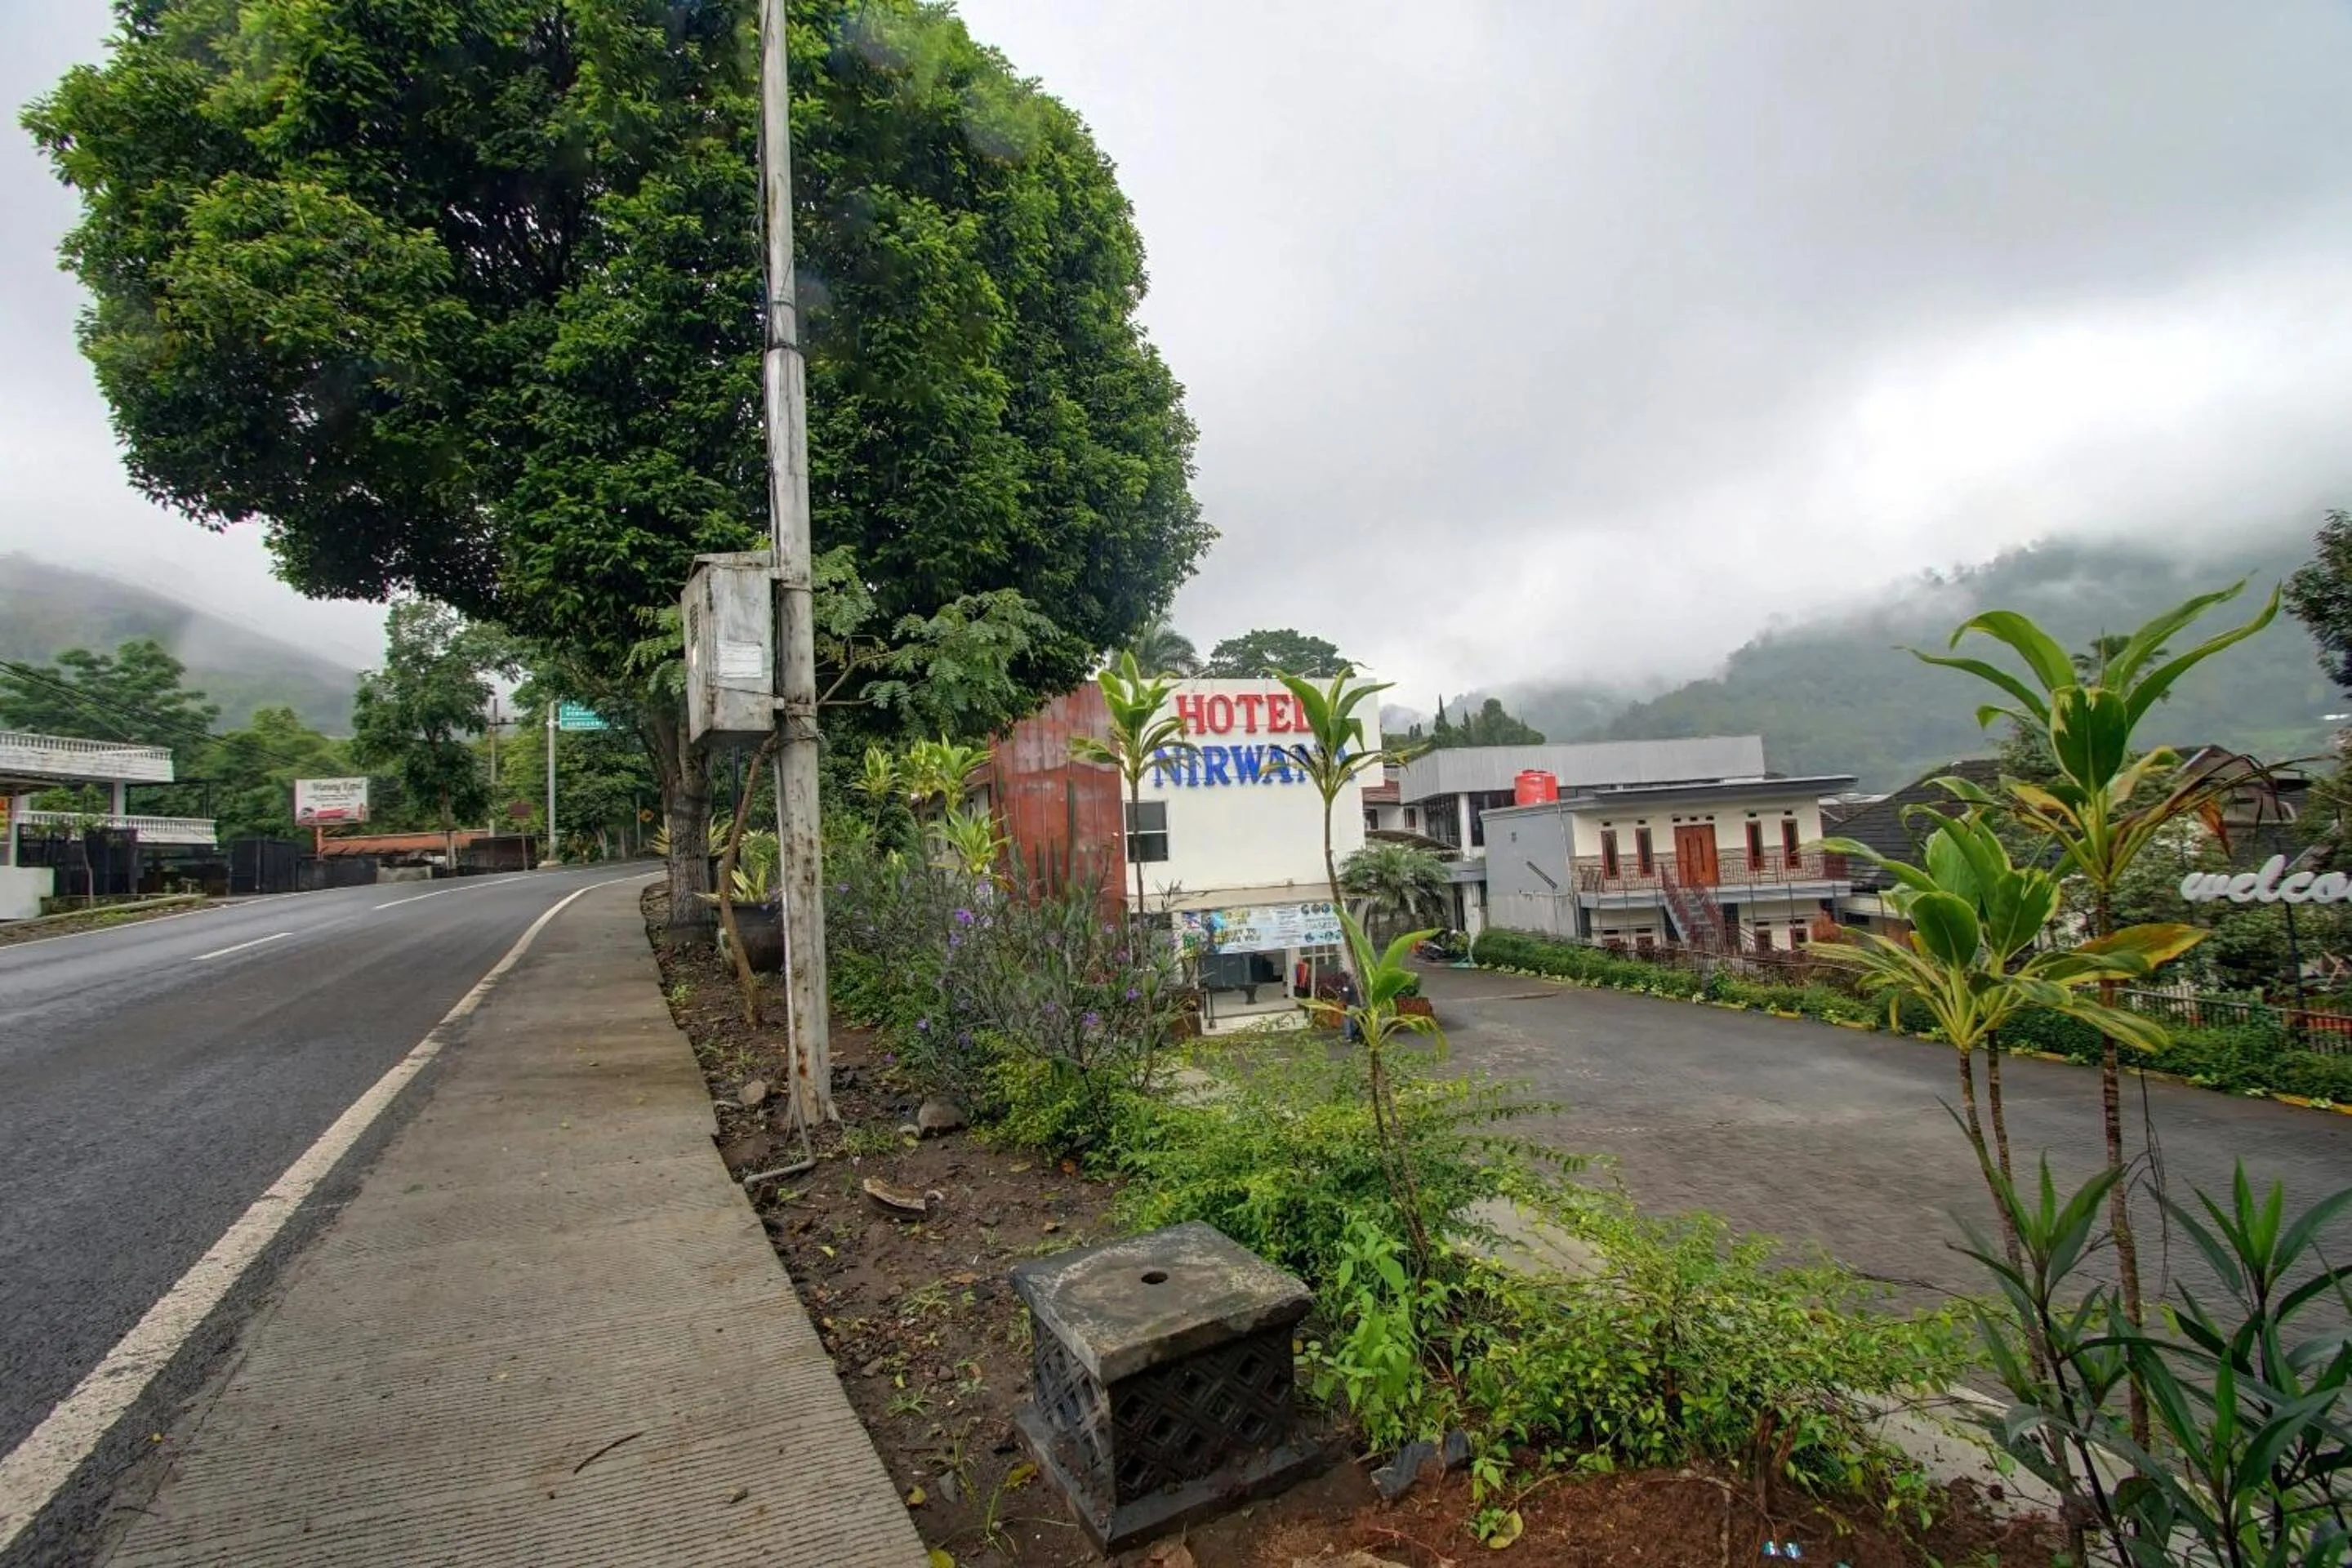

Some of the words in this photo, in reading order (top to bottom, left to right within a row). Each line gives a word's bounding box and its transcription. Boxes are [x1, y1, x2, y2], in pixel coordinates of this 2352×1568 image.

[1176, 693, 1313, 734] HOTEL
[1153, 743, 1356, 787] NIRWA
[2180, 854, 2352, 903] welco
